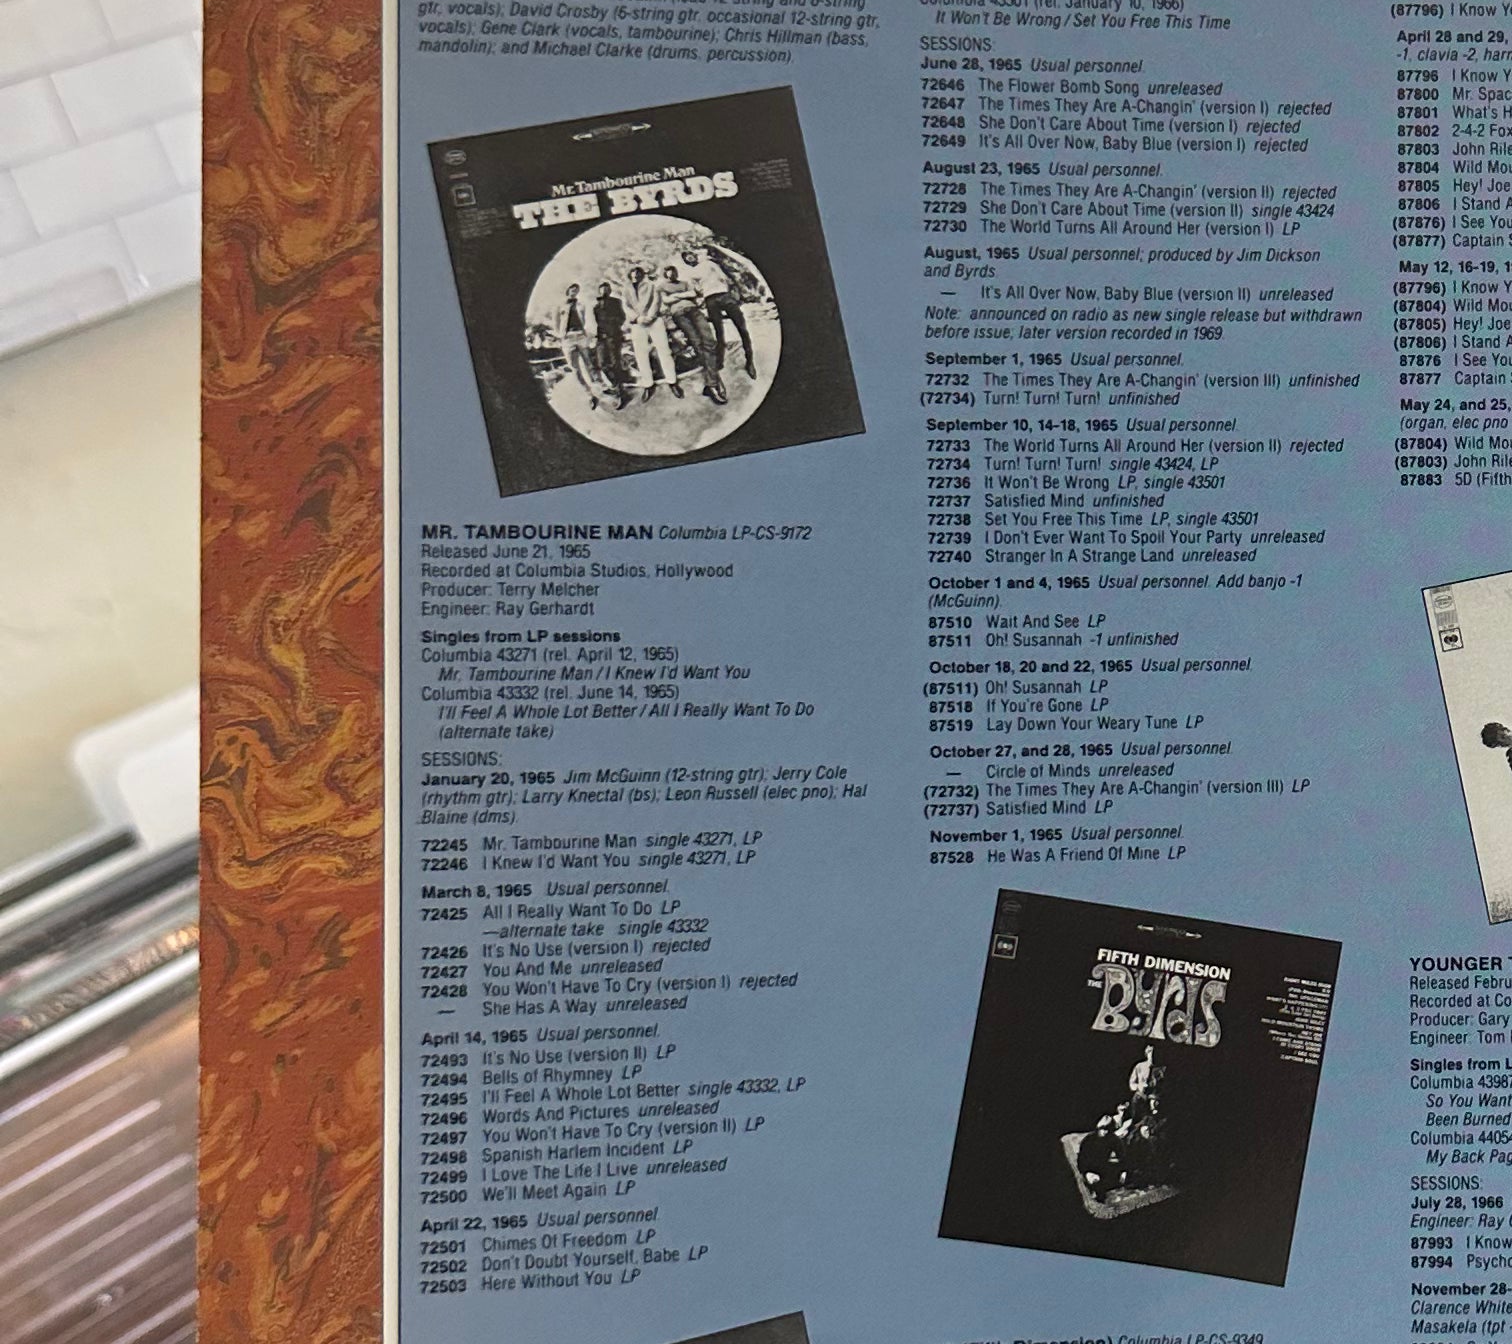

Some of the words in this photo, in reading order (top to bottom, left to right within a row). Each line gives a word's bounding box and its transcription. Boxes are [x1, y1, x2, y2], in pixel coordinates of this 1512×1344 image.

[919, 77, 965, 91] 72646
[978, 76, 1003, 92] The
[1008, 77, 1054, 93] Flower
[1060, 78, 1100, 94] Bomb
[1103, 79, 1139, 98] Song
[1147, 80, 1223, 95] unreleased
[574, 172, 661, 196] Tambourine
[663, 166, 696, 179] Man
[512, 193, 601, 230] THE
[607, 171, 739, 215] BYRDS
[924, 351, 1007, 367] September
[1011, 352, 1024, 367] 1,
[1028, 352, 1062, 365] 1965
[1070, 351, 1110, 366] Usual
[421, 524, 457, 539] MR.
[463, 524, 601, 540] TAMBOURINE
[607, 524, 653, 539] MAN
[658, 525, 726, 539] Columbia
[731, 525, 812, 540] LP-CS-9172
[927, 549, 971, 563] 72740
[985, 548, 1046, 565] Stranger
[1050, 547, 1062, 562] In
[1067, 548, 1077, 562] A
[1082, 548, 1136, 565] Strange
[1140, 547, 1173, 562] Land
[1181, 547, 1257, 562] unreleased
[421, 629, 479, 646] Singles
[484, 629, 521, 643] from
[526, 629, 548, 642] LP
[552, 629, 621, 642] sessions
[420, 837, 467, 852] 72245
[510, 835, 599, 850] Tambourine
[604, 833, 636, 848] Man
[645, 831, 690, 850] single
[741, 830, 762, 845] LP
[420, 885, 471, 899] March
[476, 884, 490, 899] 8,
[494, 883, 532, 897] 1965
[546, 880, 590, 896] Usual
[1097, 948, 1140, 967] FIFTH
[1144, 955, 1232, 981] DIMENSION
[1408, 956, 1502, 971] YOUNGER
[419, 1278, 466, 1294] 72503
[480, 1275, 515, 1291] Here
[521, 1272, 578, 1288] Without
[584, 1270, 612, 1285] You
[620, 1267, 641, 1284] LP
